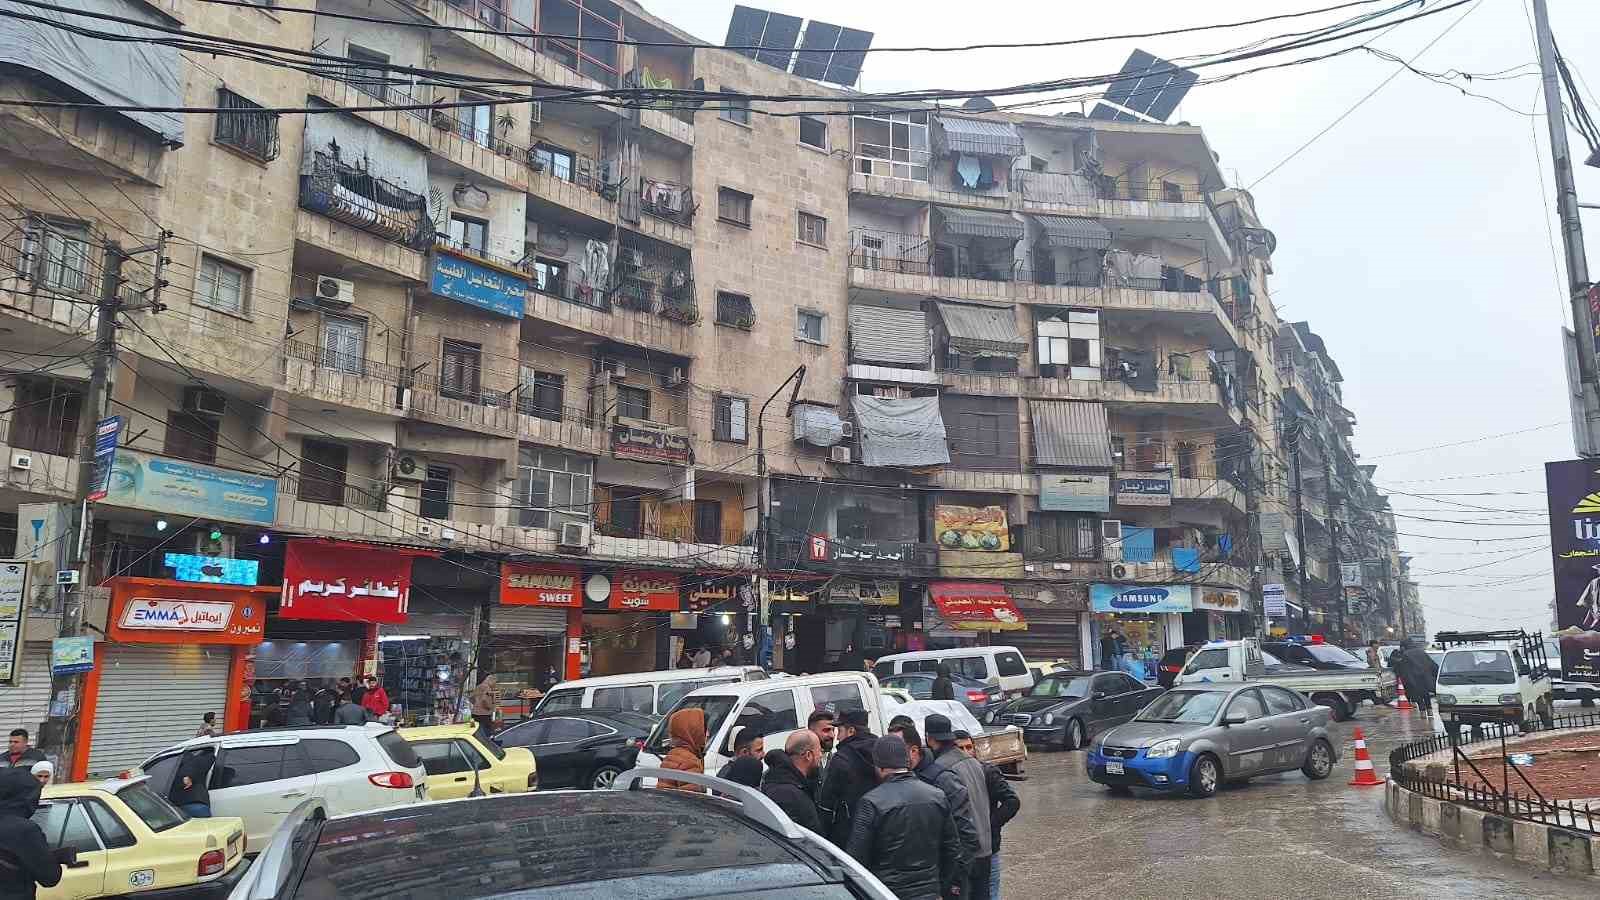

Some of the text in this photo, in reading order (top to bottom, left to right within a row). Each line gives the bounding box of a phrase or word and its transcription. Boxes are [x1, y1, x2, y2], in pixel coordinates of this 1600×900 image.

[538, 592, 573, 603] SWEET
[1117, 592, 1162, 603] SAMSUNG
[134, 609, 179, 621] EMMA
